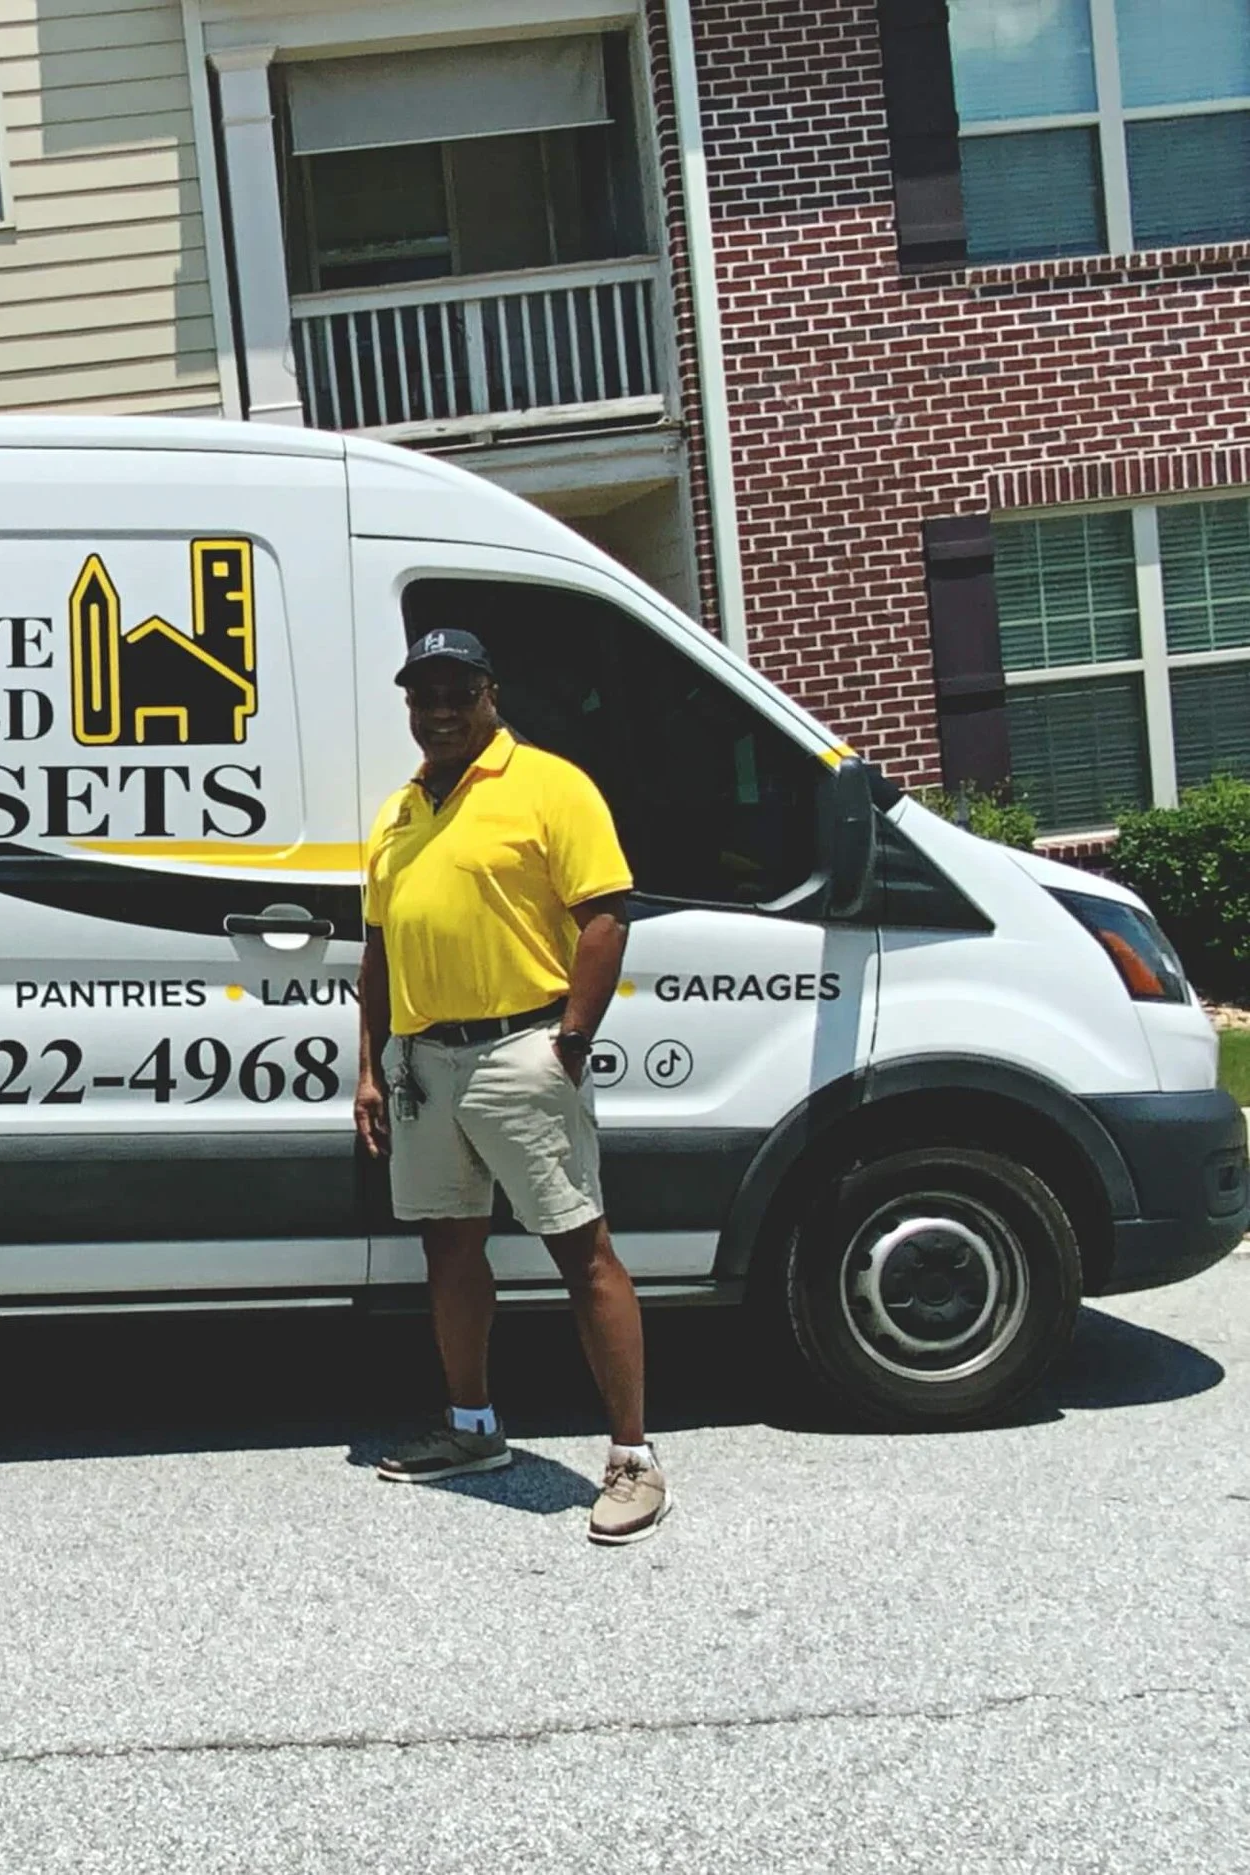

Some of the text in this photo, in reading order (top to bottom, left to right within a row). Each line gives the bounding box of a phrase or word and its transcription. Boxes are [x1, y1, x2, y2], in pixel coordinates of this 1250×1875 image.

[16, 979, 207, 1008] PANTRIES
[261, 978, 360, 1006] LAUN
[654, 972, 842, 1002] GARAGES
